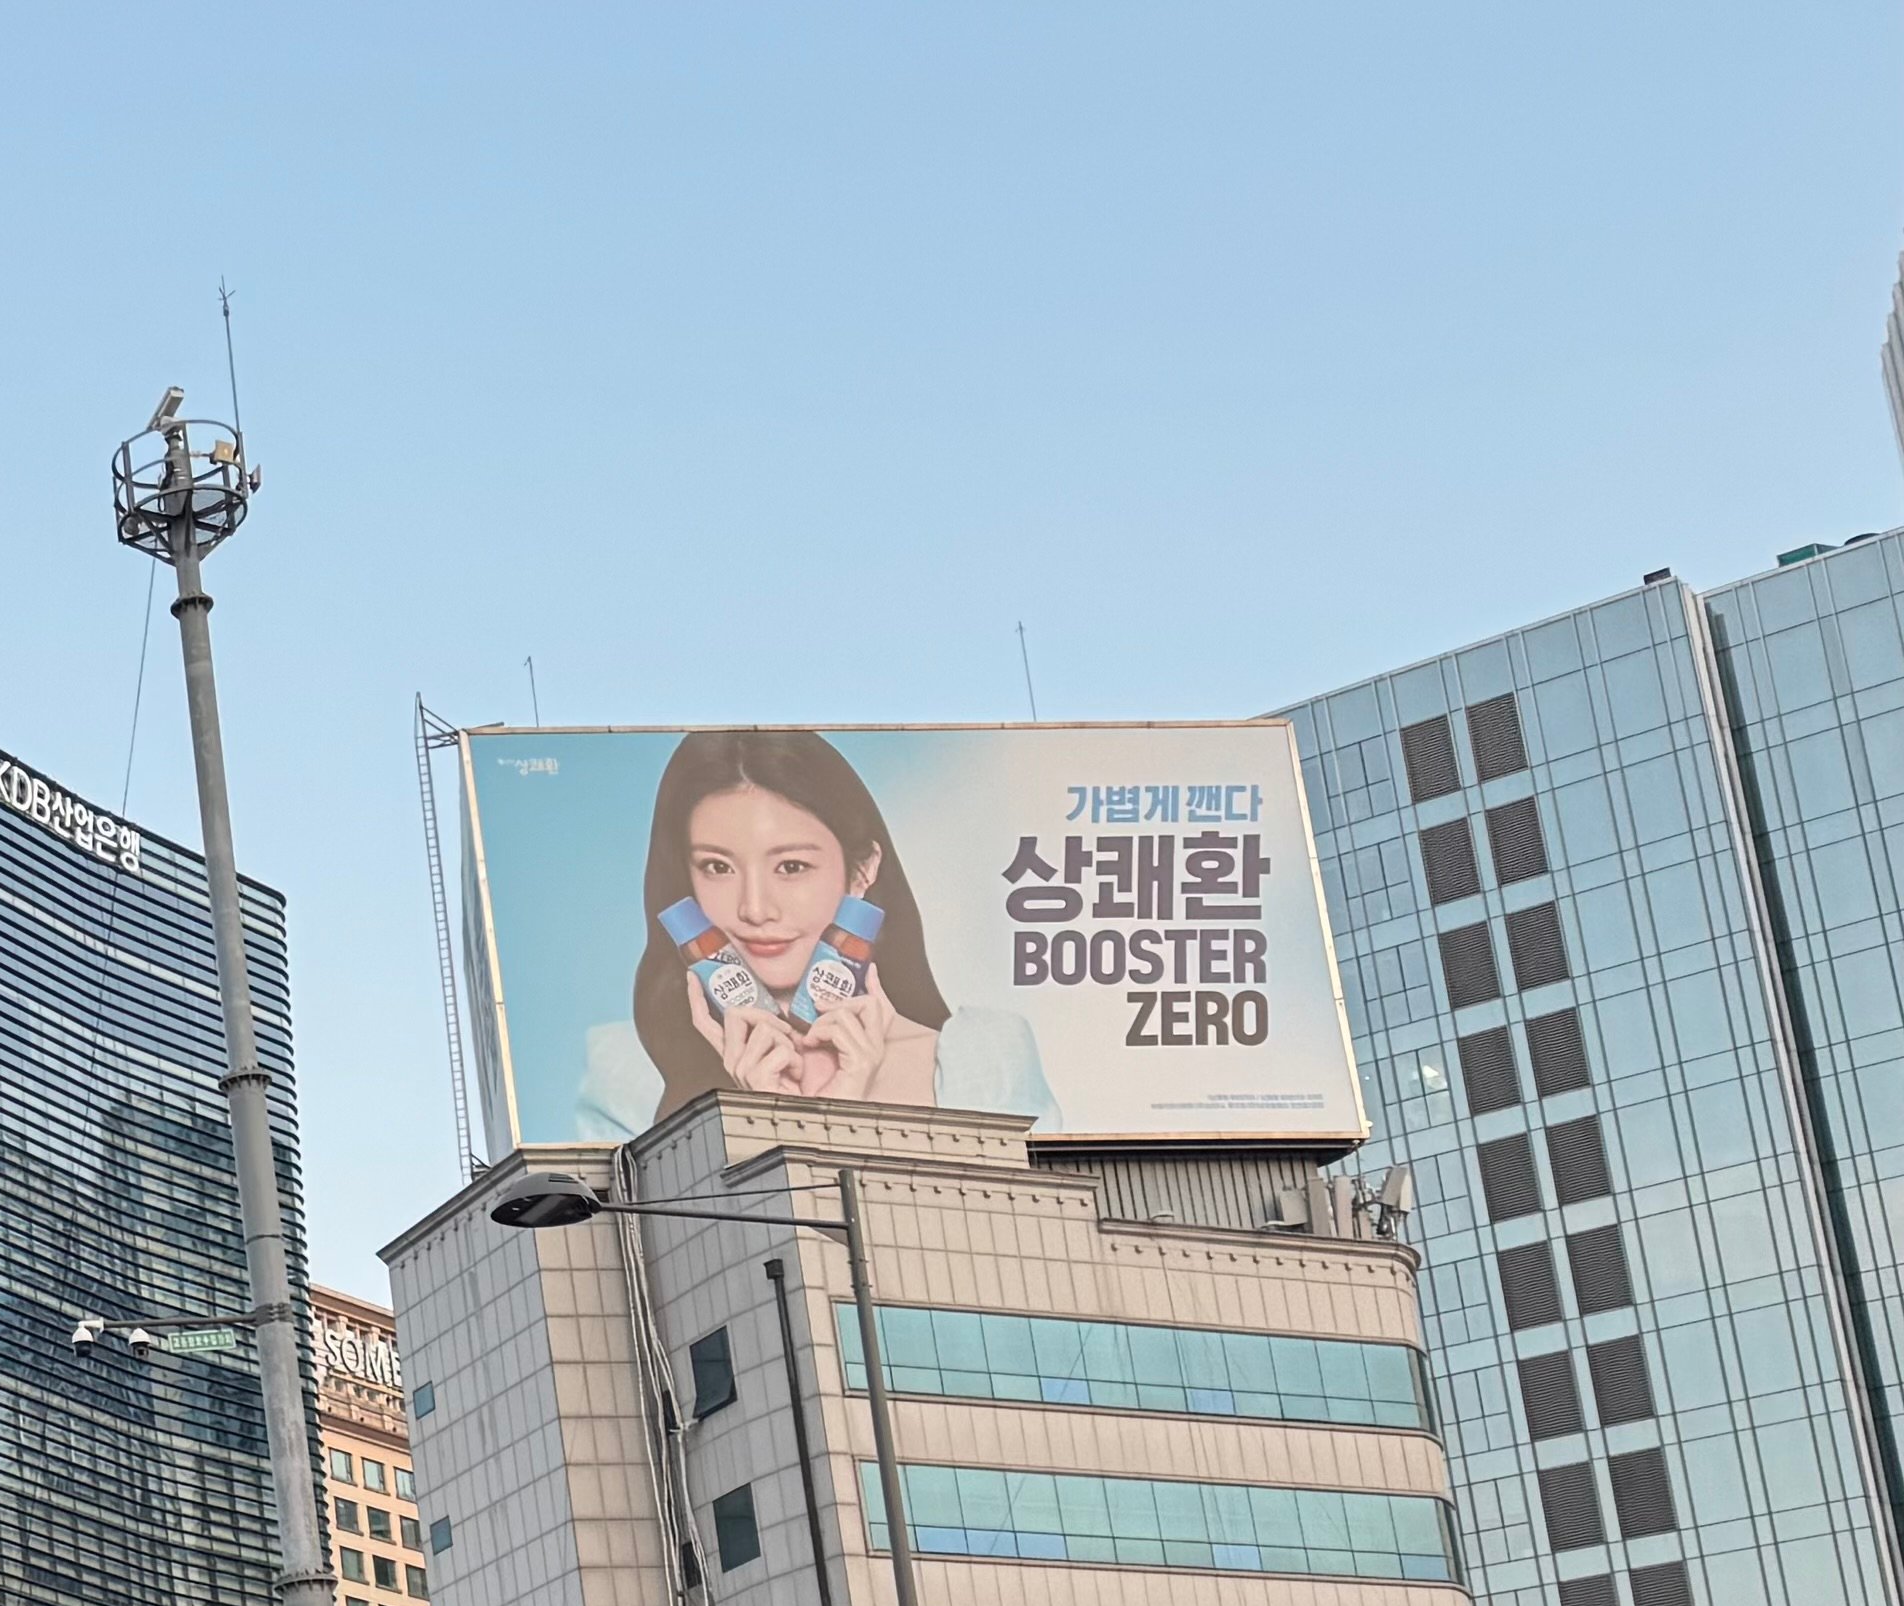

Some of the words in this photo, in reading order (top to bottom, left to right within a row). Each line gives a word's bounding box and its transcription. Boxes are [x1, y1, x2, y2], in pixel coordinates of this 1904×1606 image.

[1066, 785, 1174, 824] 가볍게
[1185, 784, 1263, 824] 깬다
[1001, 831, 1271, 924] 상쾌환
[812, 966, 854, 998] 상쾌환
[1012, 928, 1268, 987] BOOSTER
[713, 970, 753, 1001] 상쾌환
[1125, 990, 1269, 1048] ZERO
